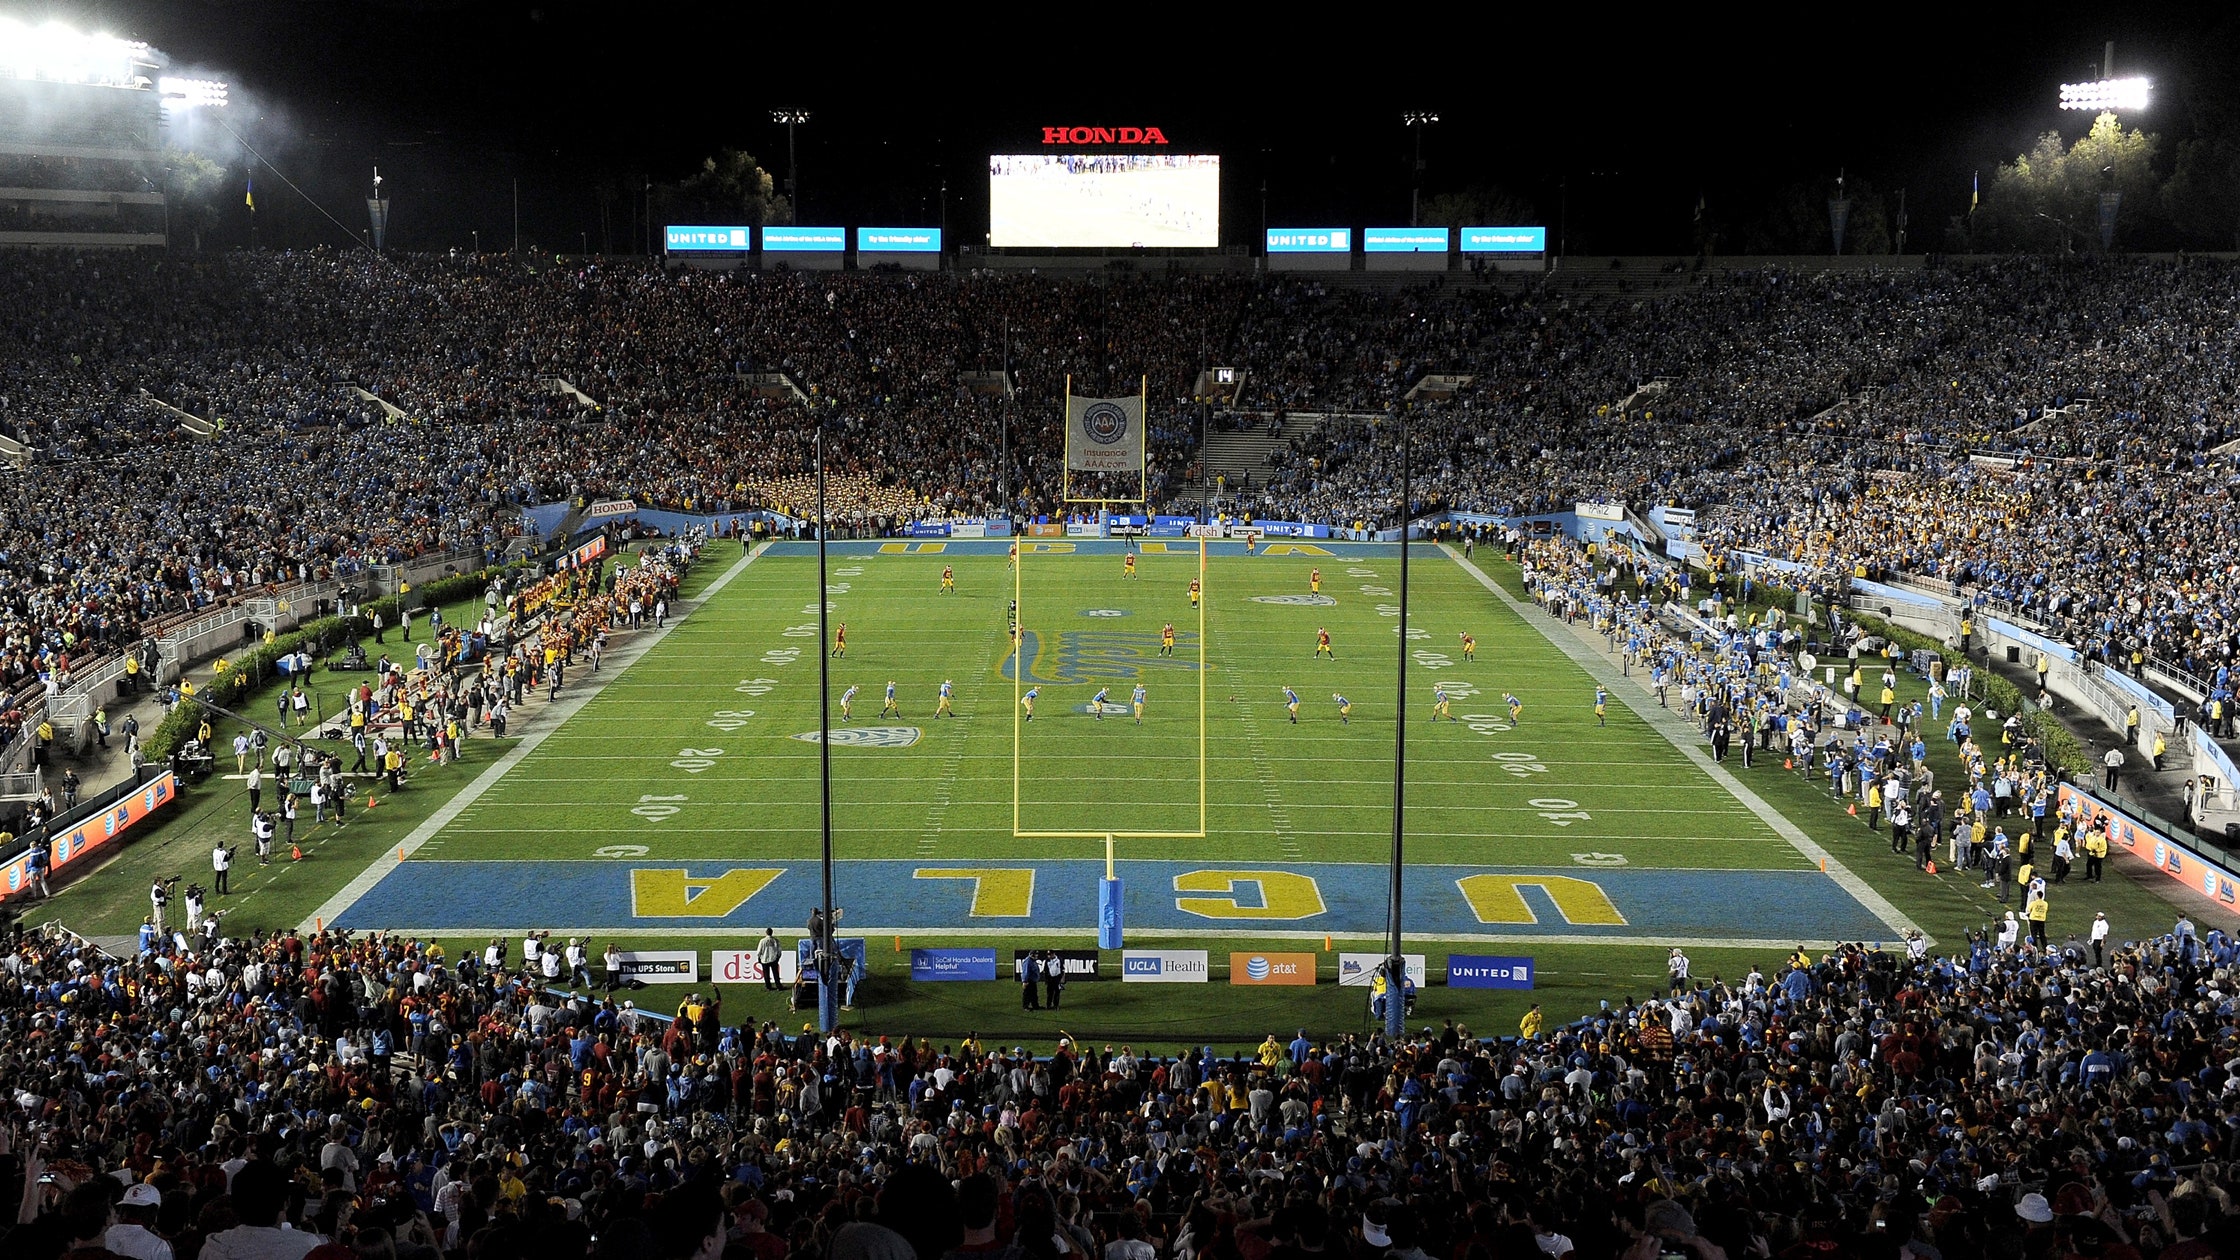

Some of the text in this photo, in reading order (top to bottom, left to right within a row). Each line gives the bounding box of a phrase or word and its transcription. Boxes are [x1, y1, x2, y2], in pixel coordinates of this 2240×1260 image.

[1042, 127, 1168, 144] HONDA
[668, 233, 728, 244] UNITED
[1269, 235, 1329, 246] UNITED
[1218, 369, 1232, 383] 14
[1094, 416, 1115, 428] AAA
[1083, 448, 1128, 457] Insurance
[1084, 460, 1127, 469] AAA.com
[593, 503, 636, 515] HONDA
[1266, 524, 1303, 534] UNITD
[734, 678, 779, 693] 40
[706, 710, 755, 727] 30
[1461, 714, 1511, 732] 30
[670, 748, 724, 768] 20
[1491, 753, 1549, 773] 20
[630, 794, 689, 816] 10
[1528, 798, 1592, 820] 10
[629, 867, 1629, 929] UCLA
[724, 953, 785, 980] dis
[935, 956, 994, 964] SoCal Honda Dealers
[1129, 960, 1206, 972] UCLA Health
[622, 964, 675, 973] The UPS Store
[935, 963, 958, 971] Helpful
[1272, 963, 1297, 974] at&t
[1453, 967, 1510, 978] UNITED
[440, 998, 447, 1011] 2
[403, 1004, 410, 1019] 7
[583, 1072, 592, 1087] 9
